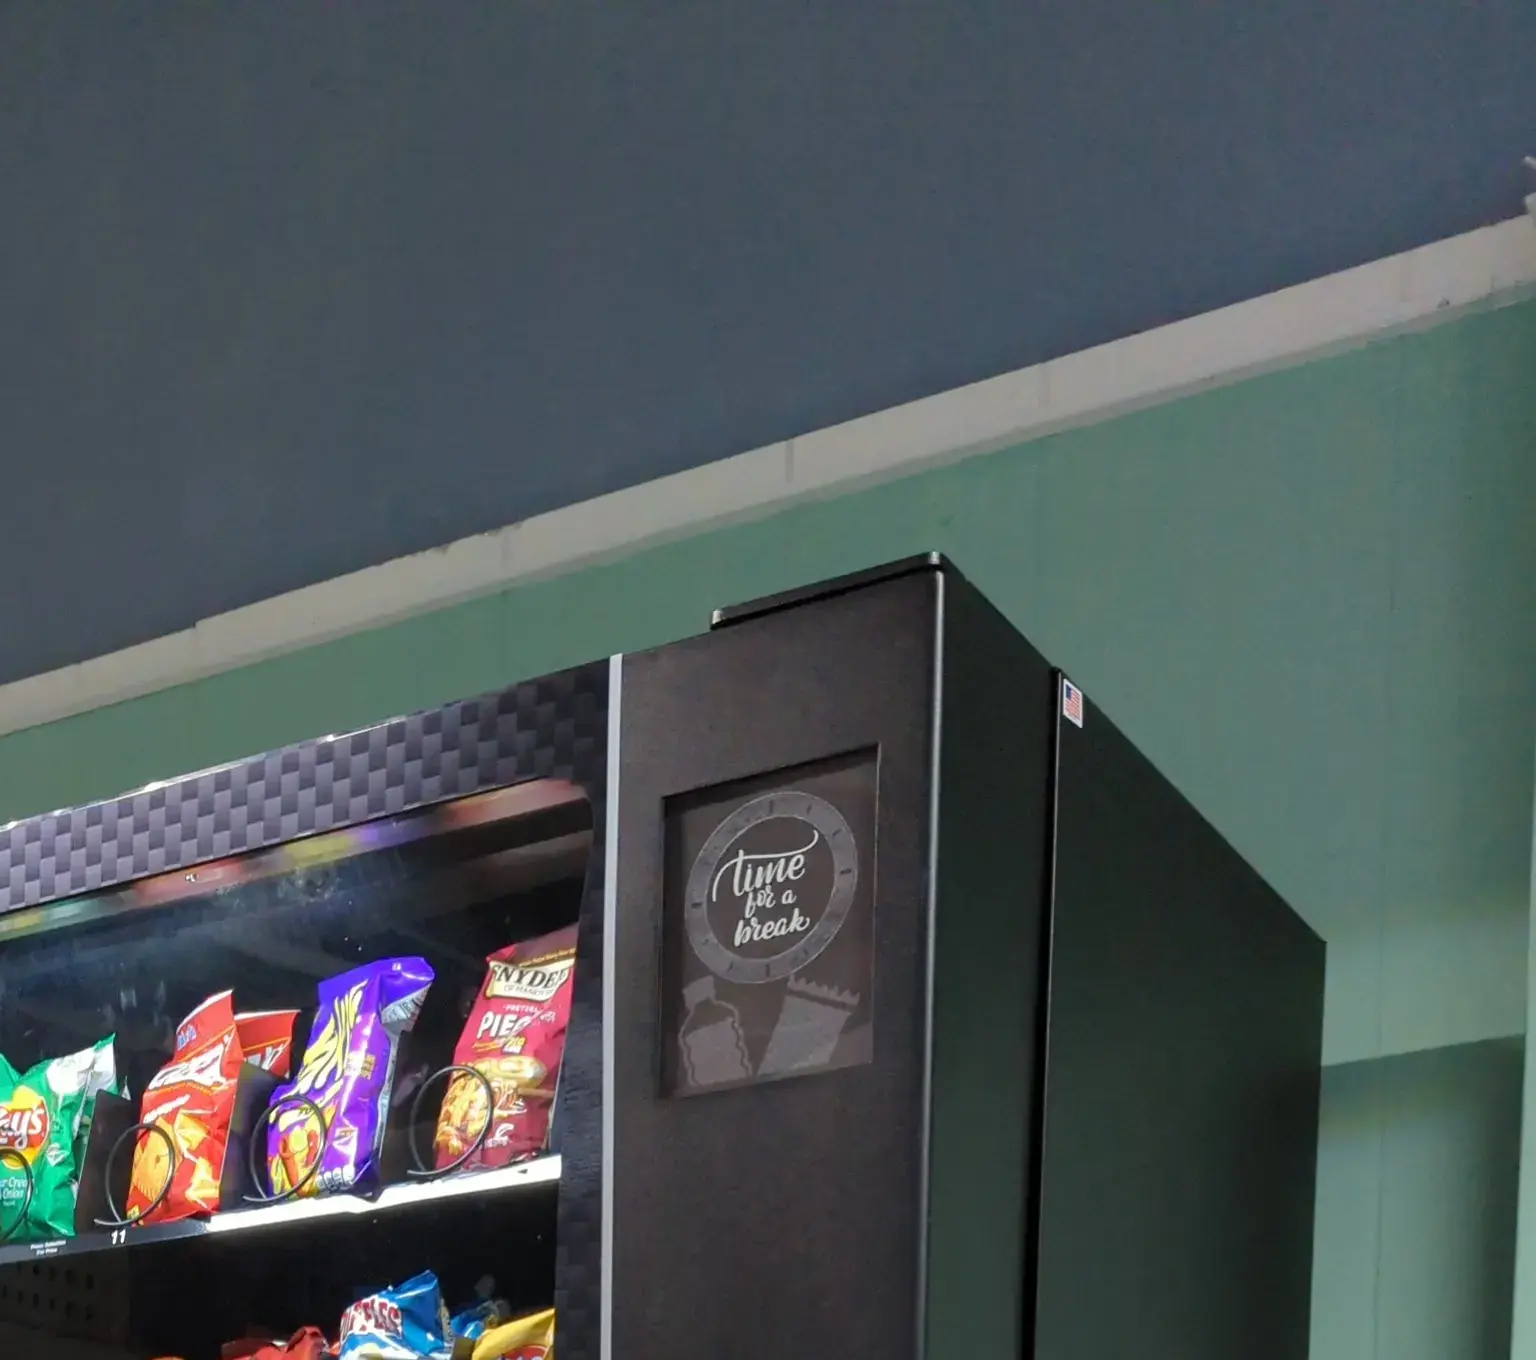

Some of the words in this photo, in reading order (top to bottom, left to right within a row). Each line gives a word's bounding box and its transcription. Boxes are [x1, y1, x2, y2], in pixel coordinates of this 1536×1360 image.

[745, 885, 776, 919] for
[781, 886, 797, 905] a
[734, 907, 810, 947] break
[110, 1229, 126, 1245] 11
